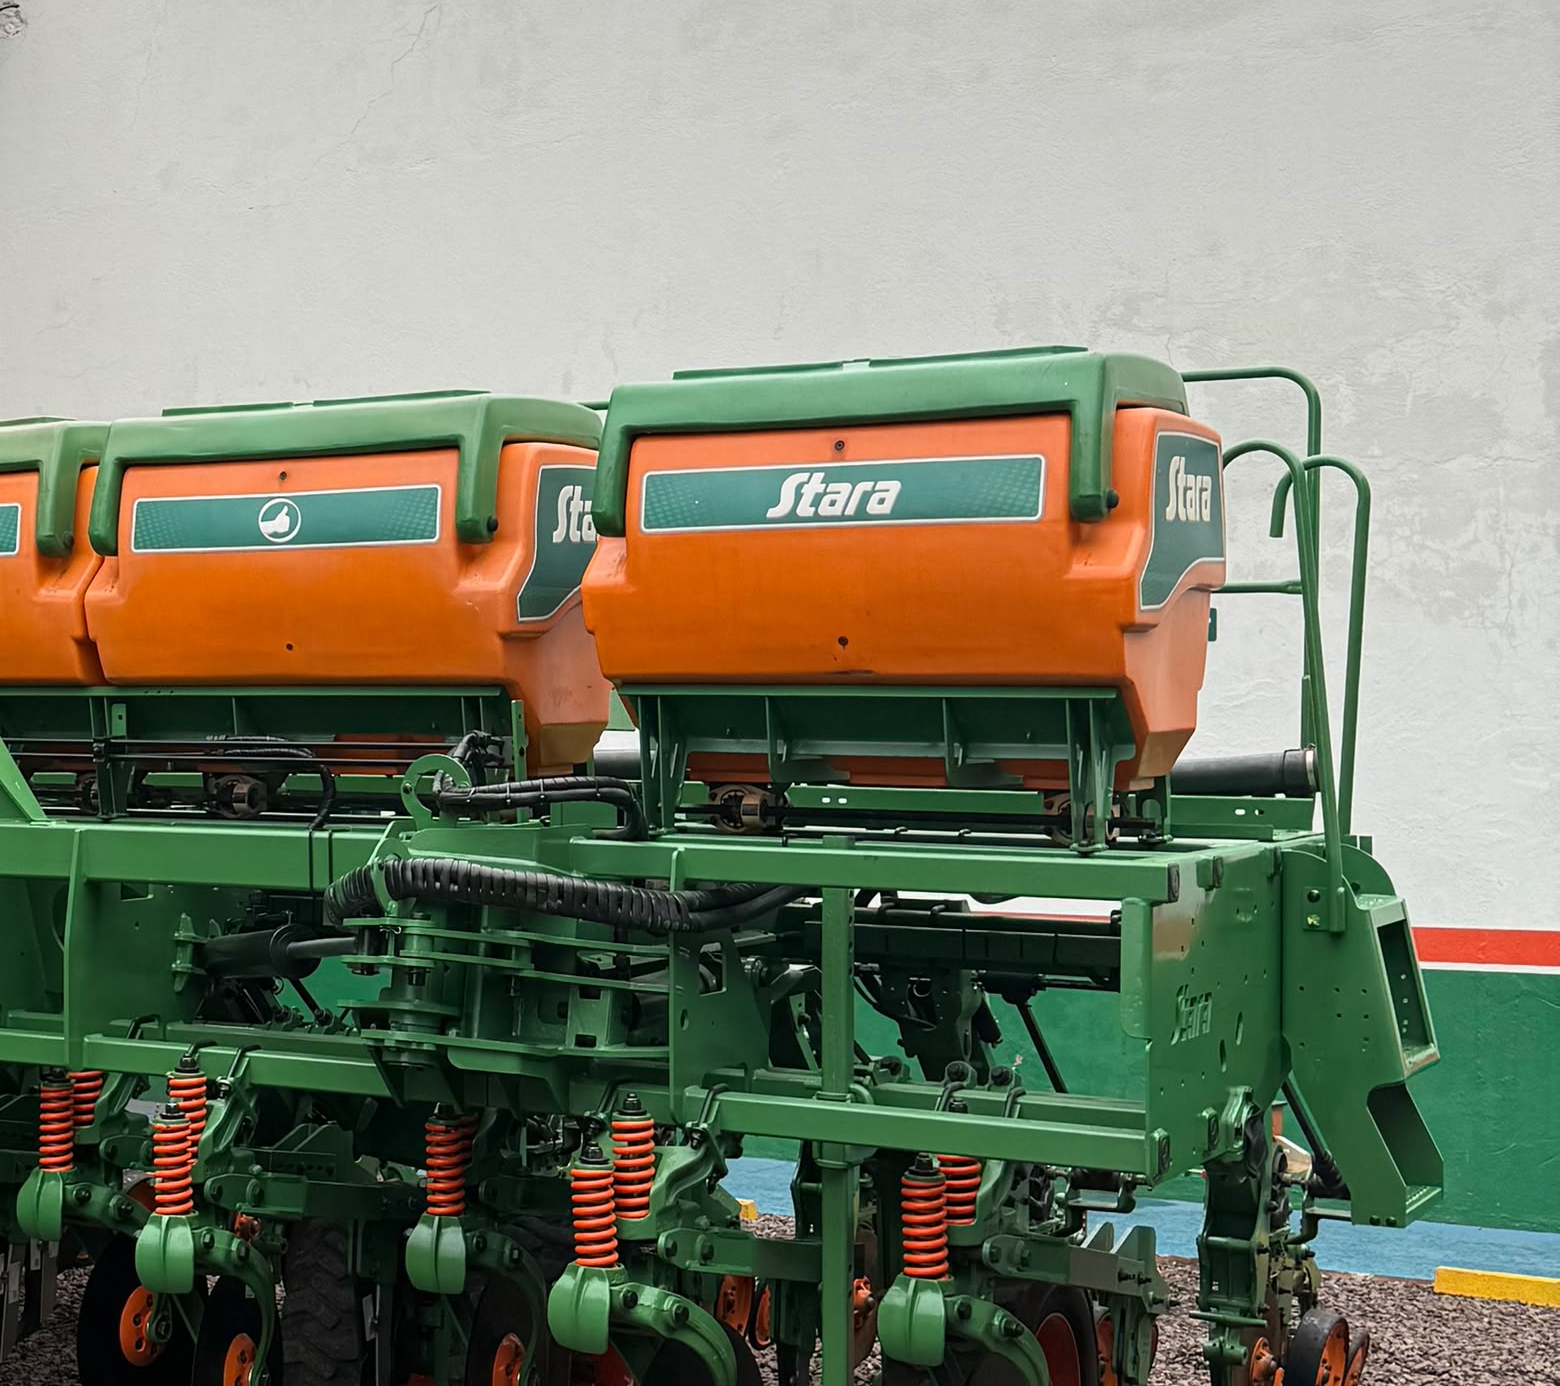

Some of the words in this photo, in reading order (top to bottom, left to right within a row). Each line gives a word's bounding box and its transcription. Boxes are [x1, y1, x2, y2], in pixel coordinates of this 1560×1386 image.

[552, 485, 597, 543] Sta
[766, 472, 902, 518] Stara
[1165, 455, 1212, 522] Stara
